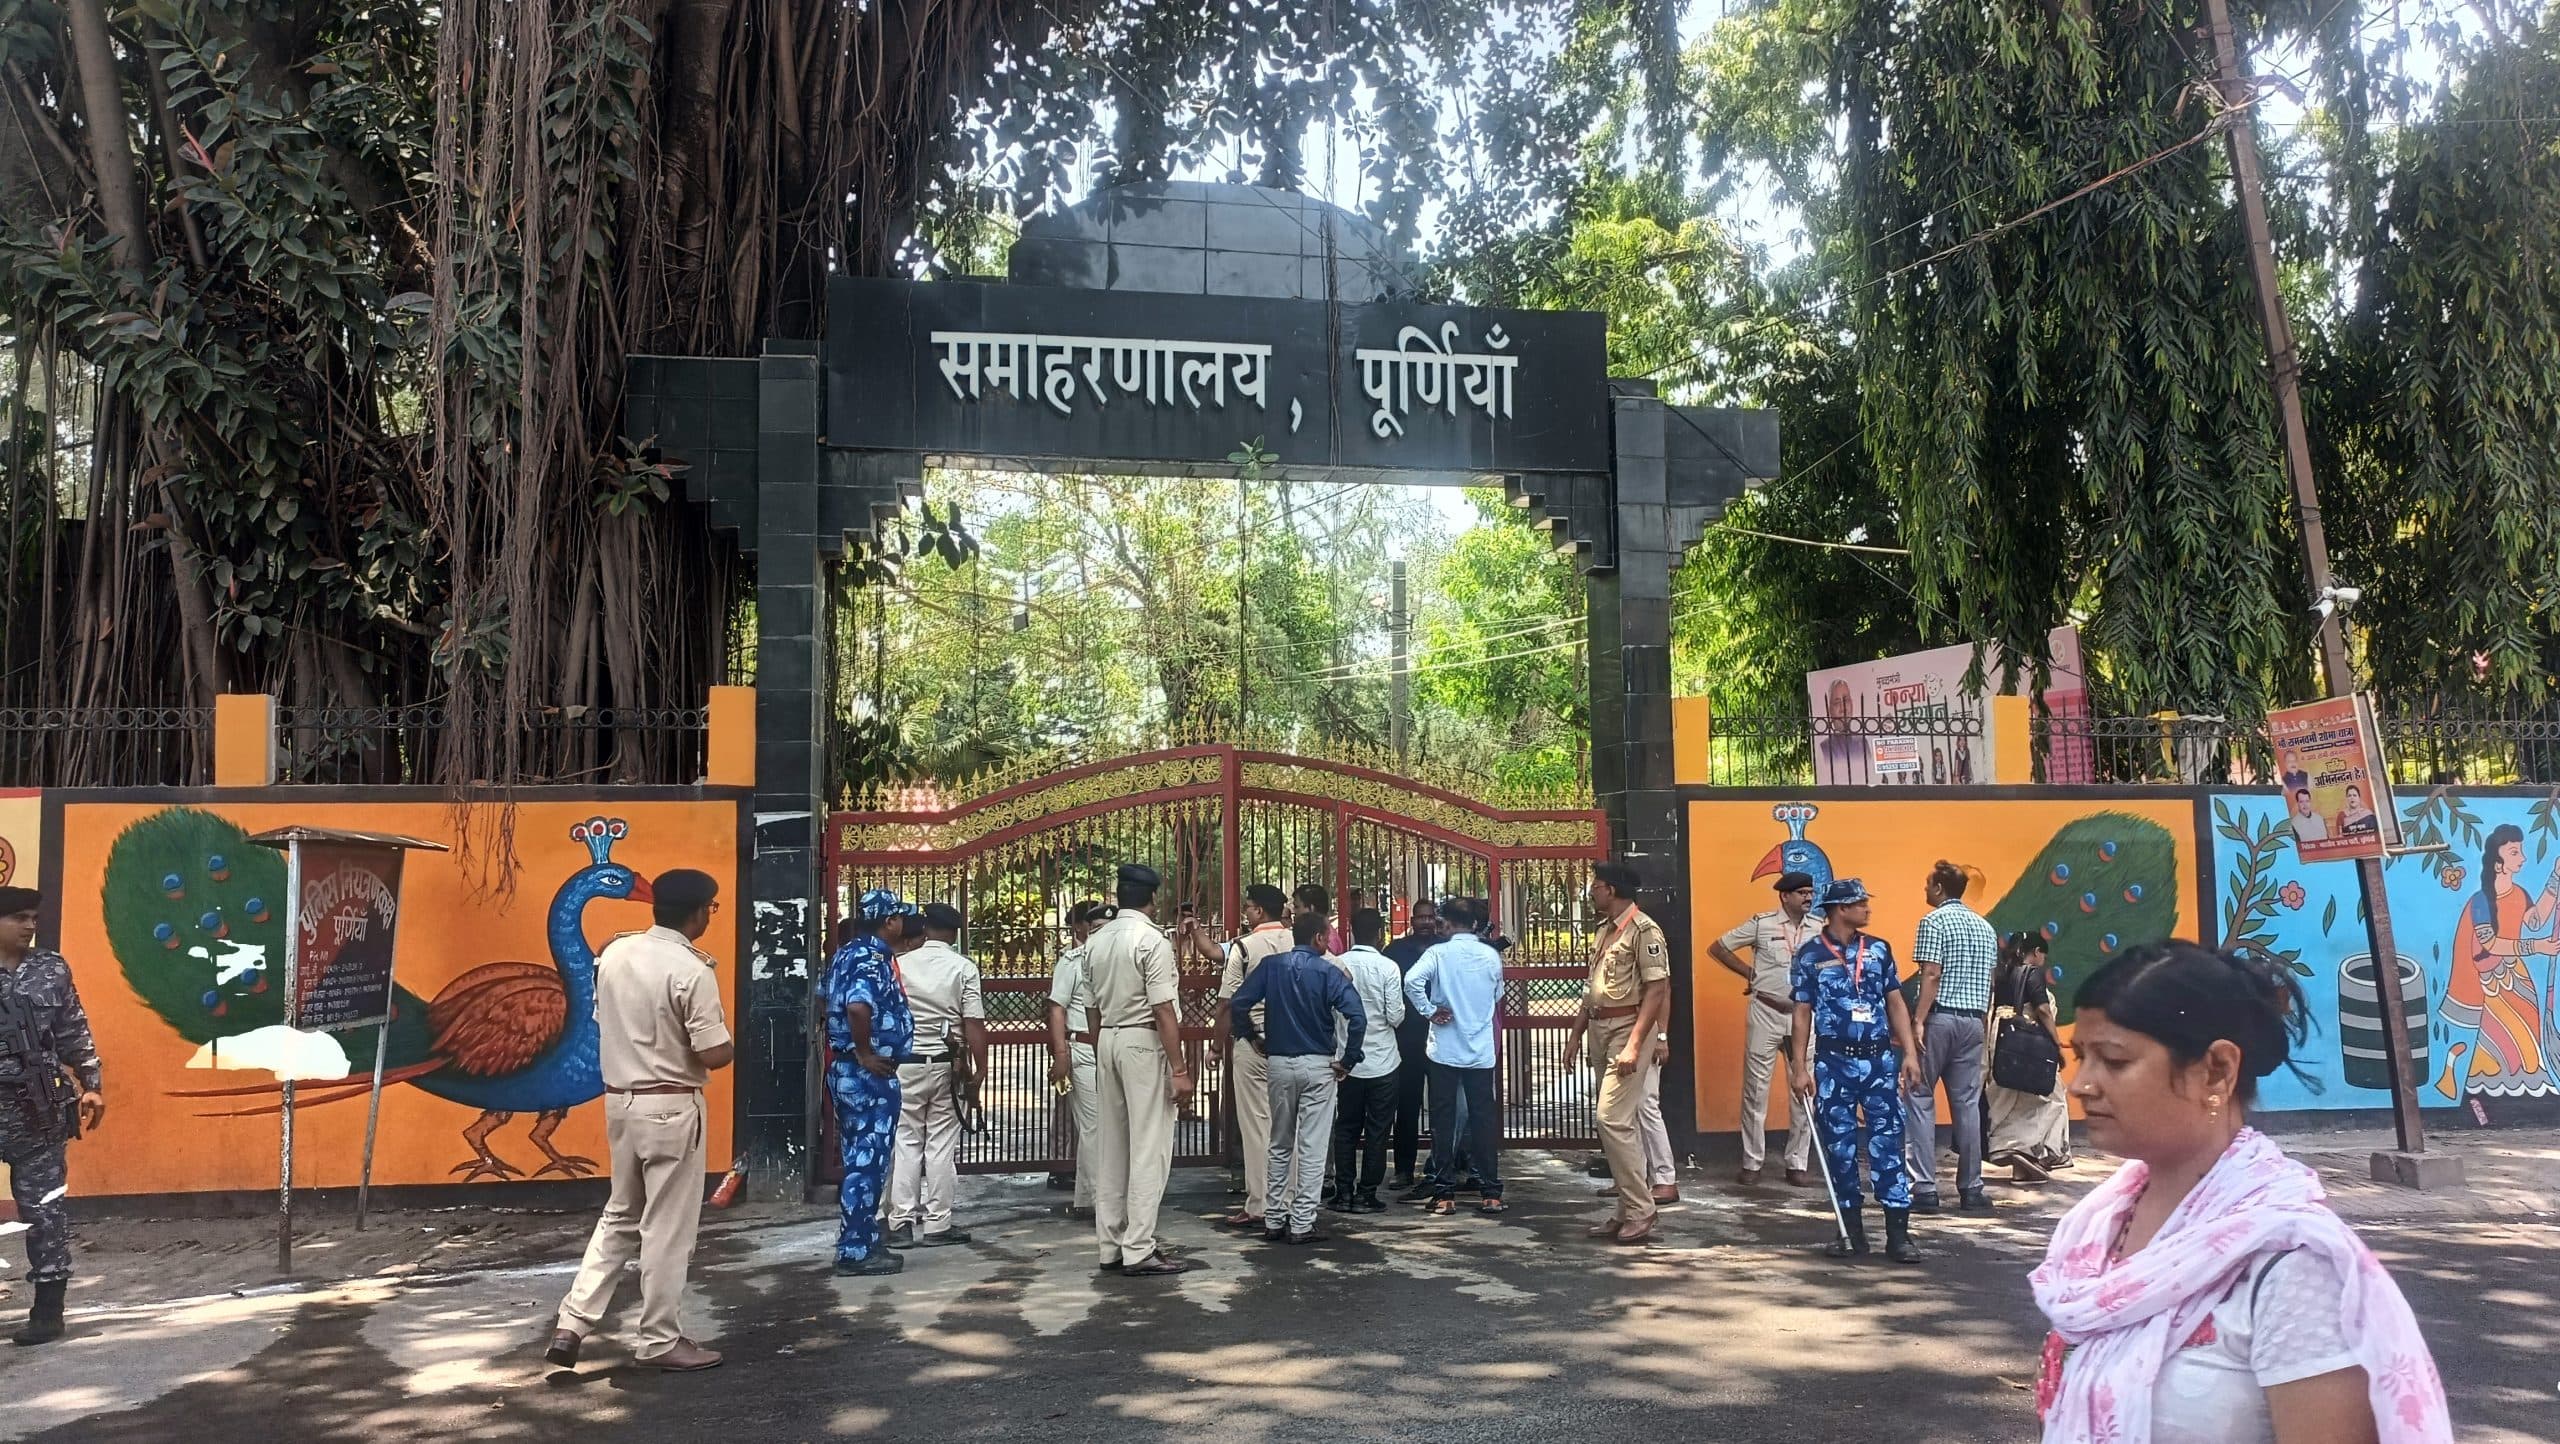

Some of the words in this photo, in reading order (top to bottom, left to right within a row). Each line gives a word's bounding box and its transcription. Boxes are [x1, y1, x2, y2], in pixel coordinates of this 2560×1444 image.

[1356, 320, 1519, 437] पूर्णियाँ
[1883, 683, 1926, 707] कन्या
[2314, 769, 2353, 787] अभिनन्दन
[299, 871, 339, 946] पुलिस
[333, 905, 369, 946] पूर्णियाँ
